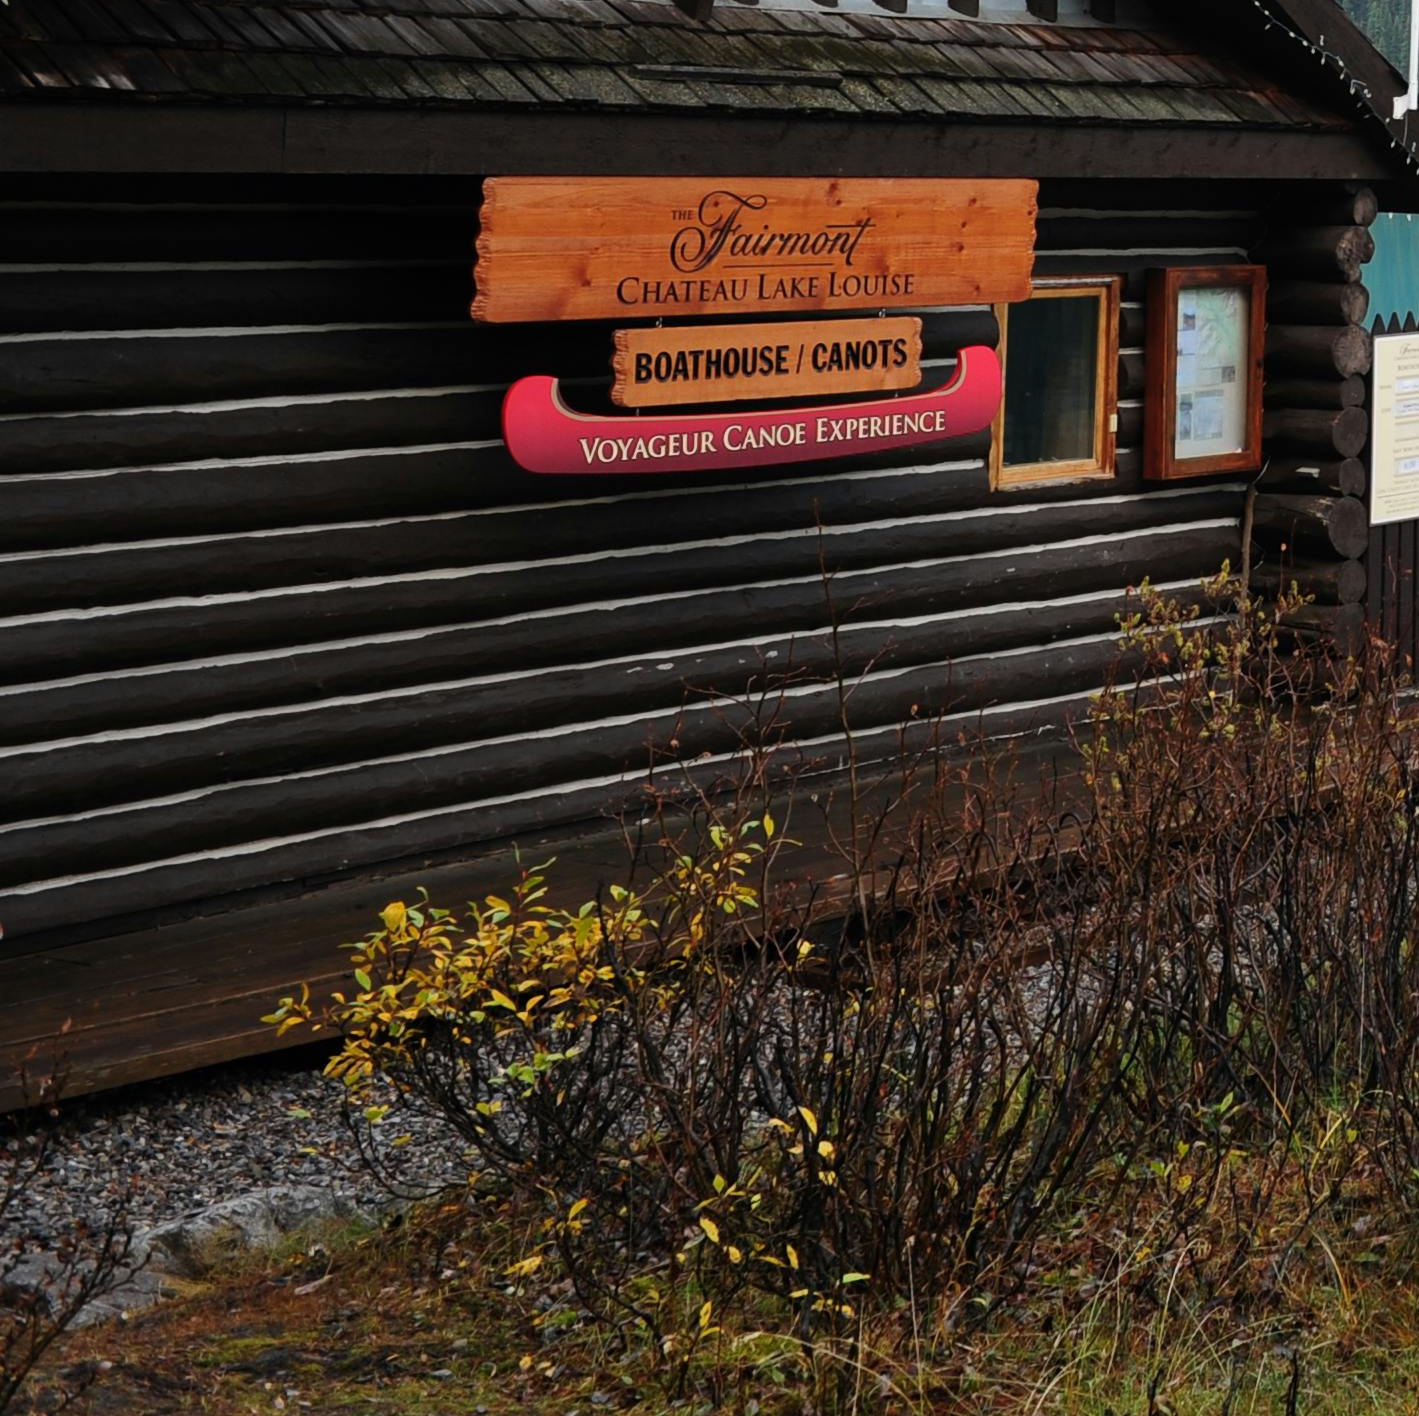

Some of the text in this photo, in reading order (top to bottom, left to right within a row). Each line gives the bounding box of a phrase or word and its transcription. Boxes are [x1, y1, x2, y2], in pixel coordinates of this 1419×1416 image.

[670, 190, 877, 273] THE Fairmont
[616, 271, 915, 305] CHATEAU LAKE LOUISE
[634, 338, 908, 384] BOATHOUSE / CANOTS
[579, 410, 947, 464] VOYAGEUR CANOE EXPERIENCE
